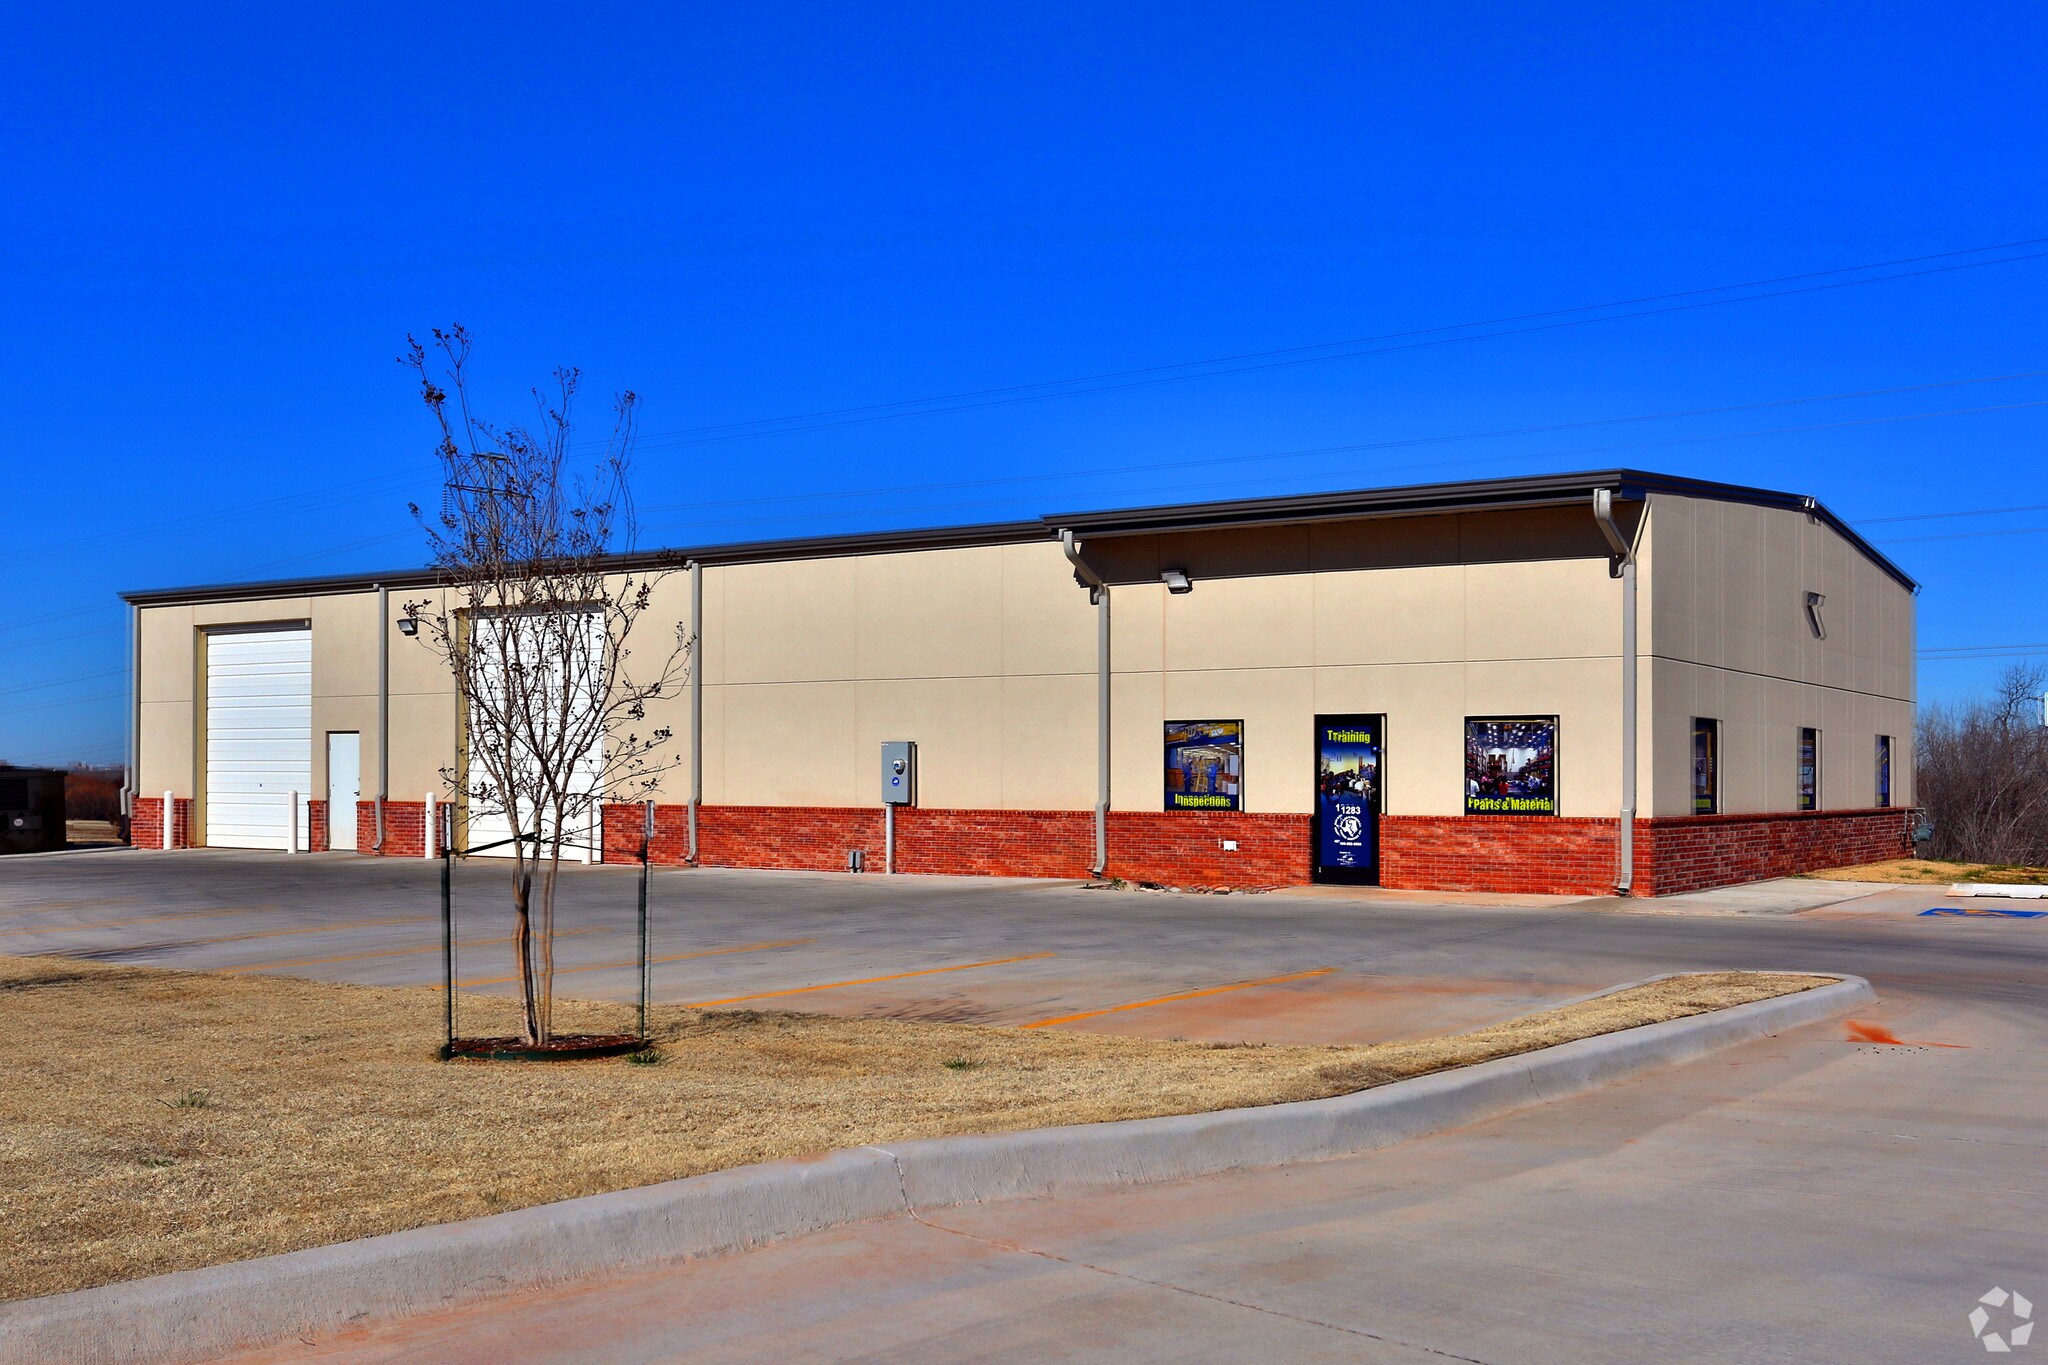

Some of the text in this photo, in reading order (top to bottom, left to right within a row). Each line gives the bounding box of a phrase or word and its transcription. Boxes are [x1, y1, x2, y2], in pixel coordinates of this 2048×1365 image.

[1329, 731, 1370, 744] Training
[1177, 795, 1231, 807] Inspections
[1471, 799, 1500, 810] Parts
[1502, 800, 1510, 810] &
[1340, 805, 1361, 815] 1283
